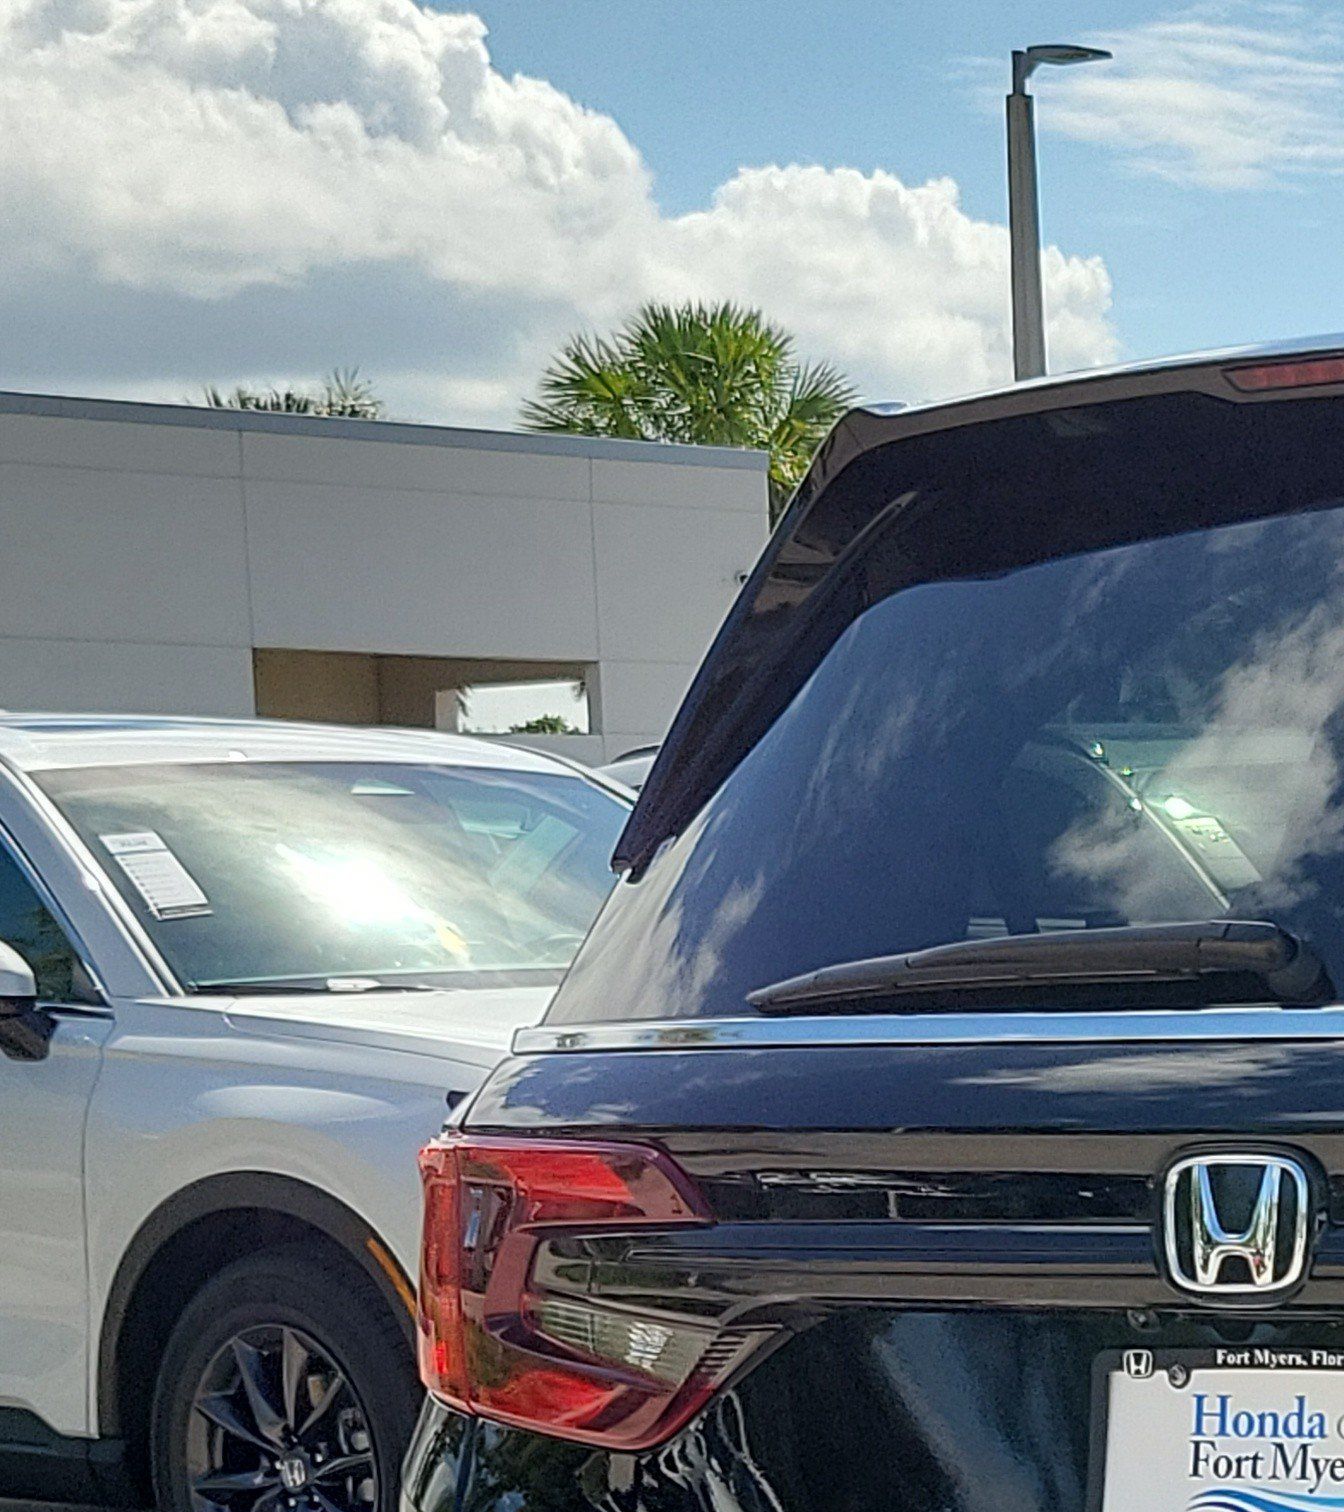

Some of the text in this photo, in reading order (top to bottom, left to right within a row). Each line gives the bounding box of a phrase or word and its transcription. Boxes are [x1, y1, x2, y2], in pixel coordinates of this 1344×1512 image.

[1215, 1349, 1251, 1366] Fort
[1189, 1393, 1328, 1439] Honda
[1188, 1439, 1264, 1479] Fort
